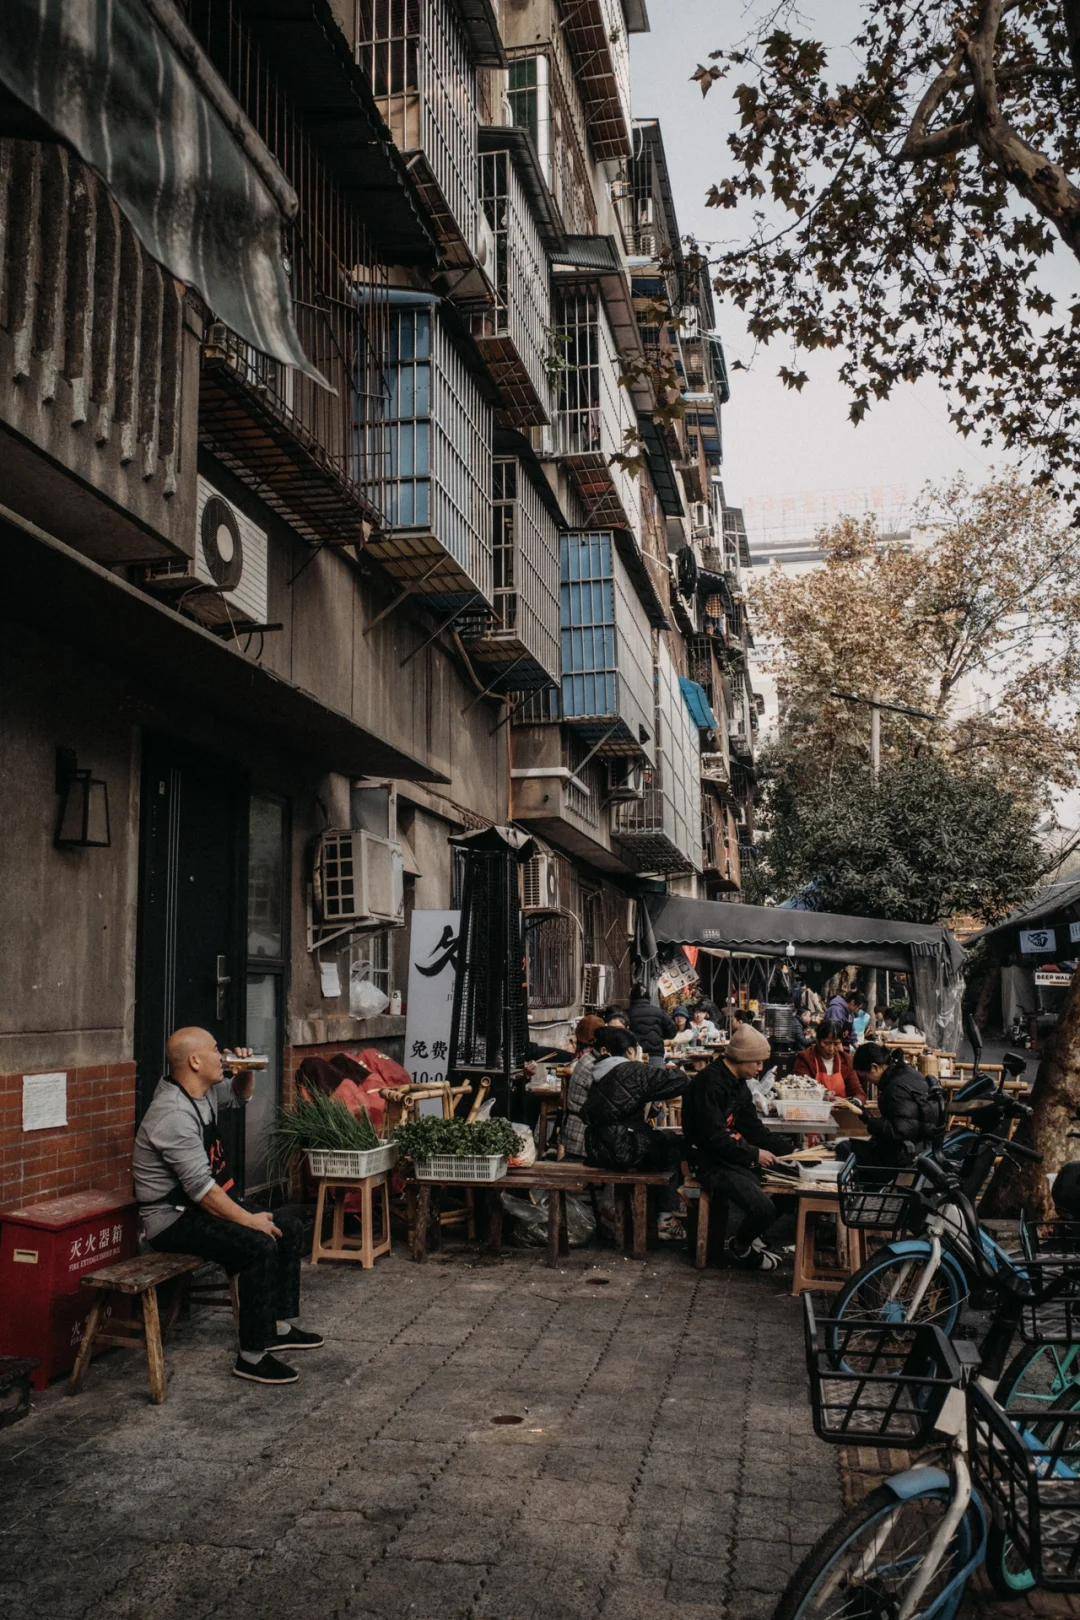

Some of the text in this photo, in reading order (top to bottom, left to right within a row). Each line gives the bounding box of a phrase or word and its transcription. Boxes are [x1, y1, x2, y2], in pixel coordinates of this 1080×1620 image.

[410, 1040, 448, 1060] 免费
[69, 1224, 123, 1261] 灭火器箱
